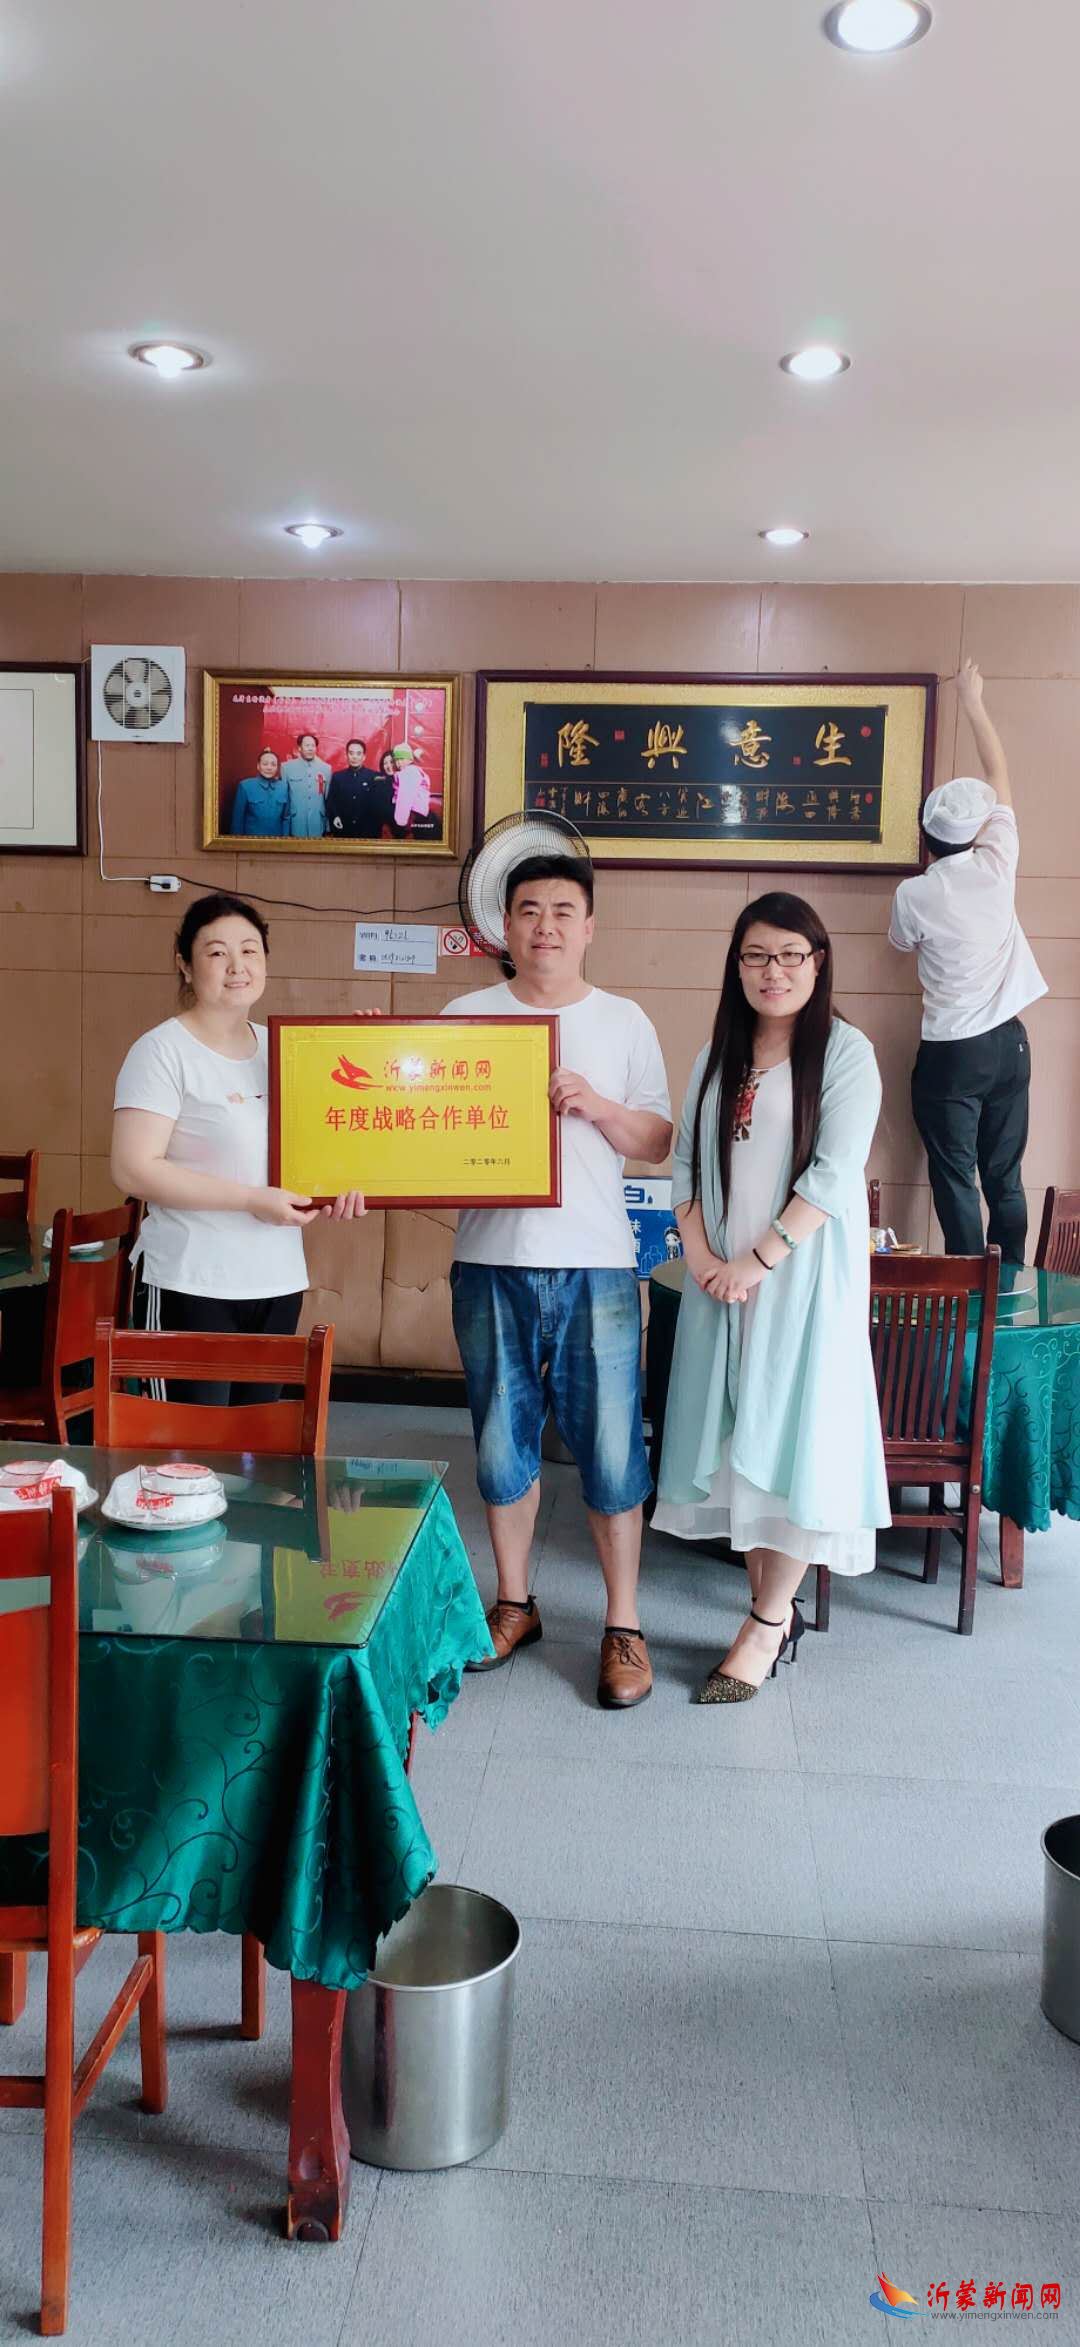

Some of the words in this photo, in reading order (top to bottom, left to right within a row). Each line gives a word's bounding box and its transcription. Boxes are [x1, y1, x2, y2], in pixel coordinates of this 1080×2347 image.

[325, 1105, 511, 1132] 年度战略合作单位
